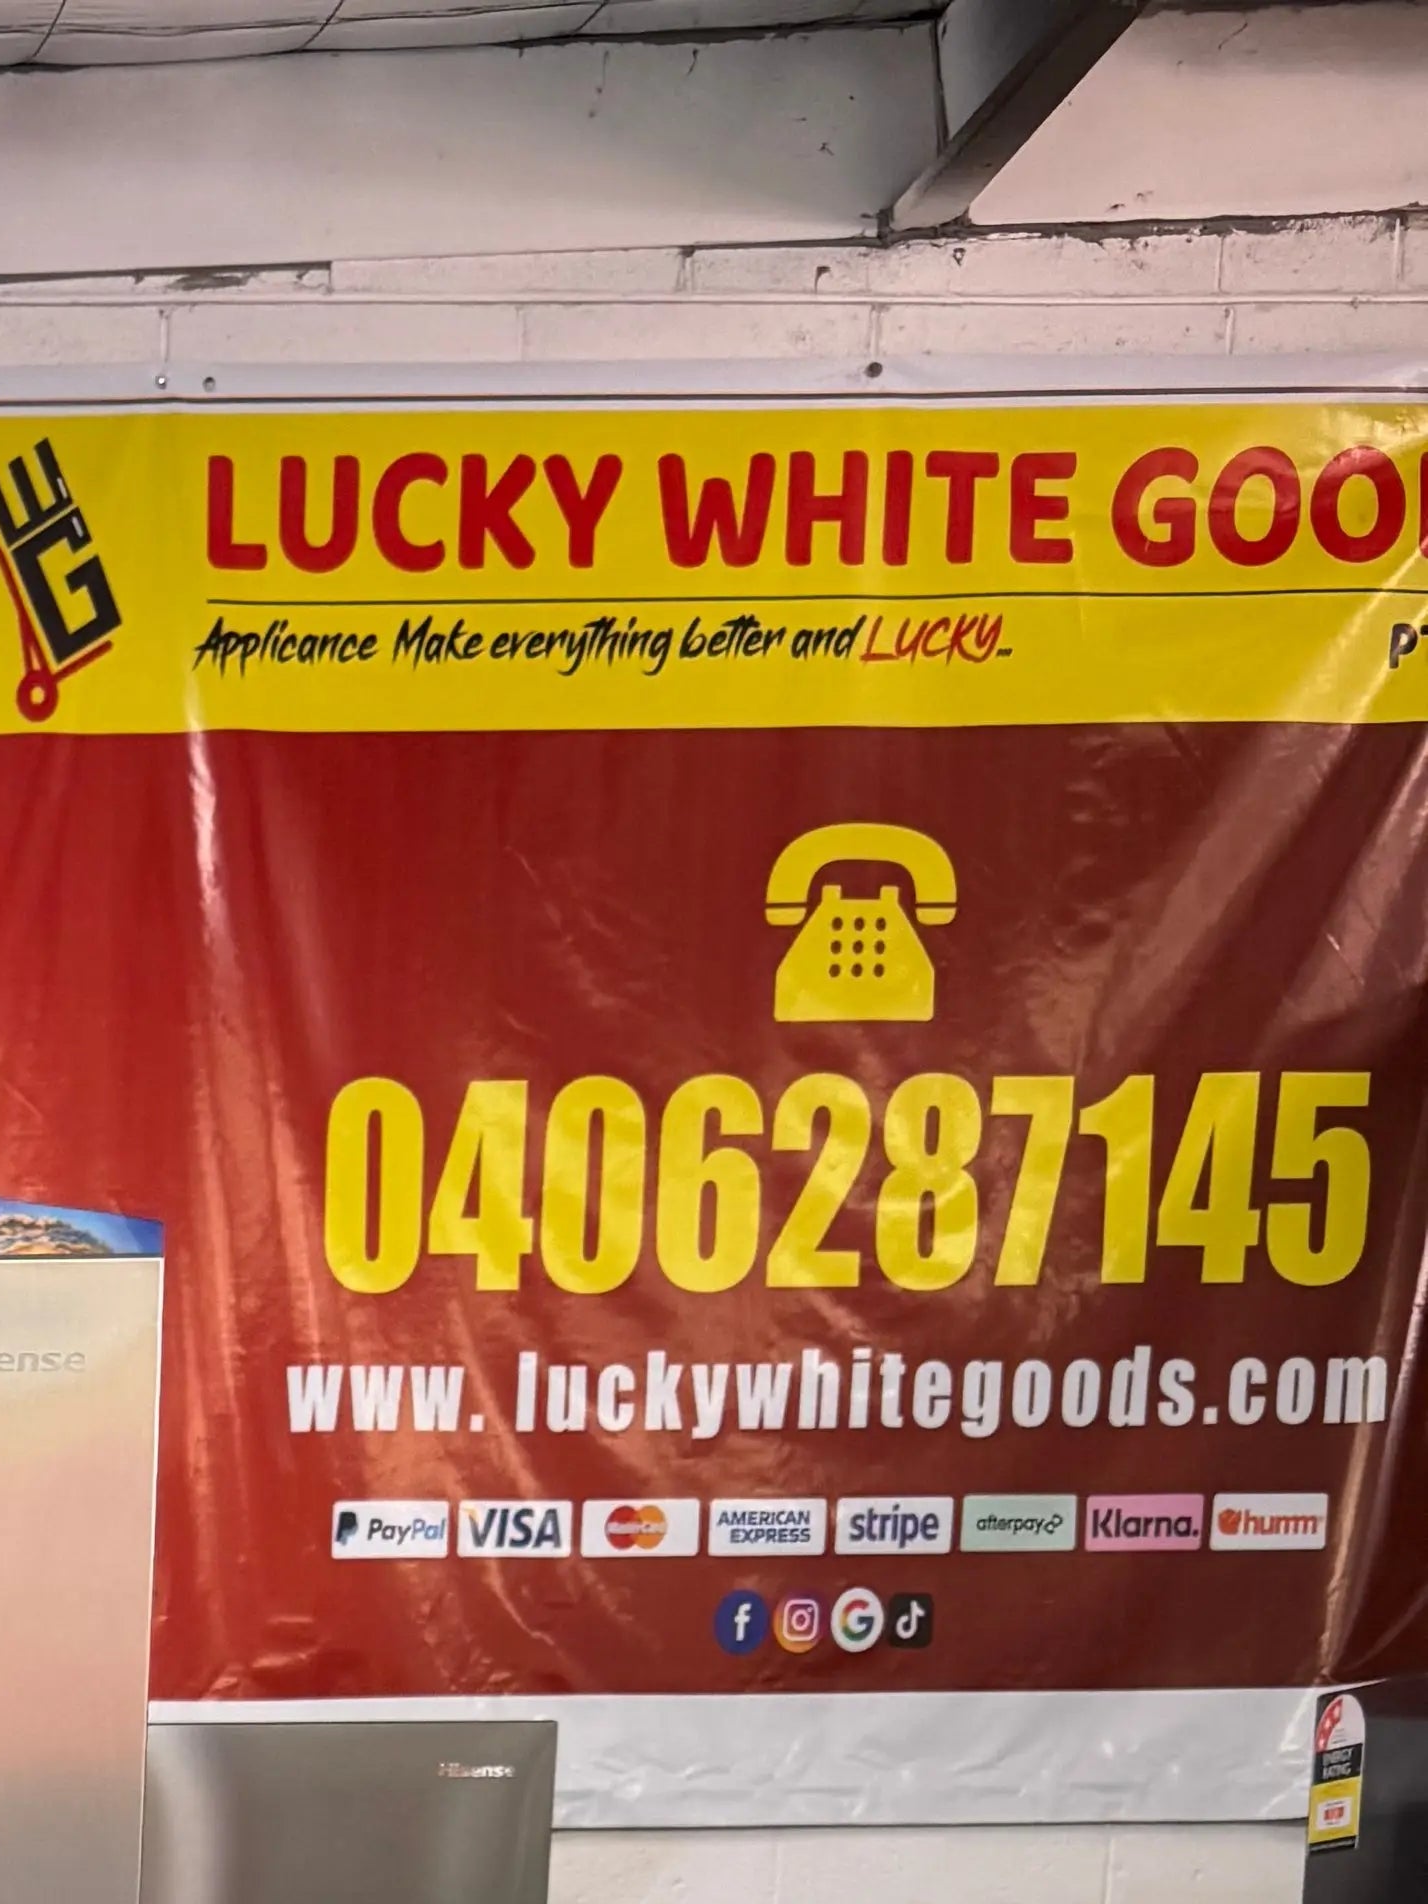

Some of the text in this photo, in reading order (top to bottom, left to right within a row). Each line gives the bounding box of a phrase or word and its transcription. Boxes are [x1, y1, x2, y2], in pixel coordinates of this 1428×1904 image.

[207, 445, 1428, 572] LUCKY WHITE GOO
[193, 618, 377, 672] Applicance
[393, 616, 485, 663] Make
[490, 616, 669, 675] everything
[679, 614, 784, 663] better
[790, 616, 857, 661] and
[324, 1071, 1372, 1293] 0406287145
[515, 1345, 1391, 1441] luckywhitegoods.com
[366, 1516, 446, 1546] PayPal
[463, 1506, 562, 1549] VISA
[716, 1510, 810, 1527] AMERICAN
[729, 1527, 810, 1544] EXPRESS
[849, 1507, 939, 1549] stripe
[975, 1514, 1042, 1537] afterpay
[1092, 1507, 1199, 1539] Klarna.
[1243, 1509, 1320, 1536] humm
